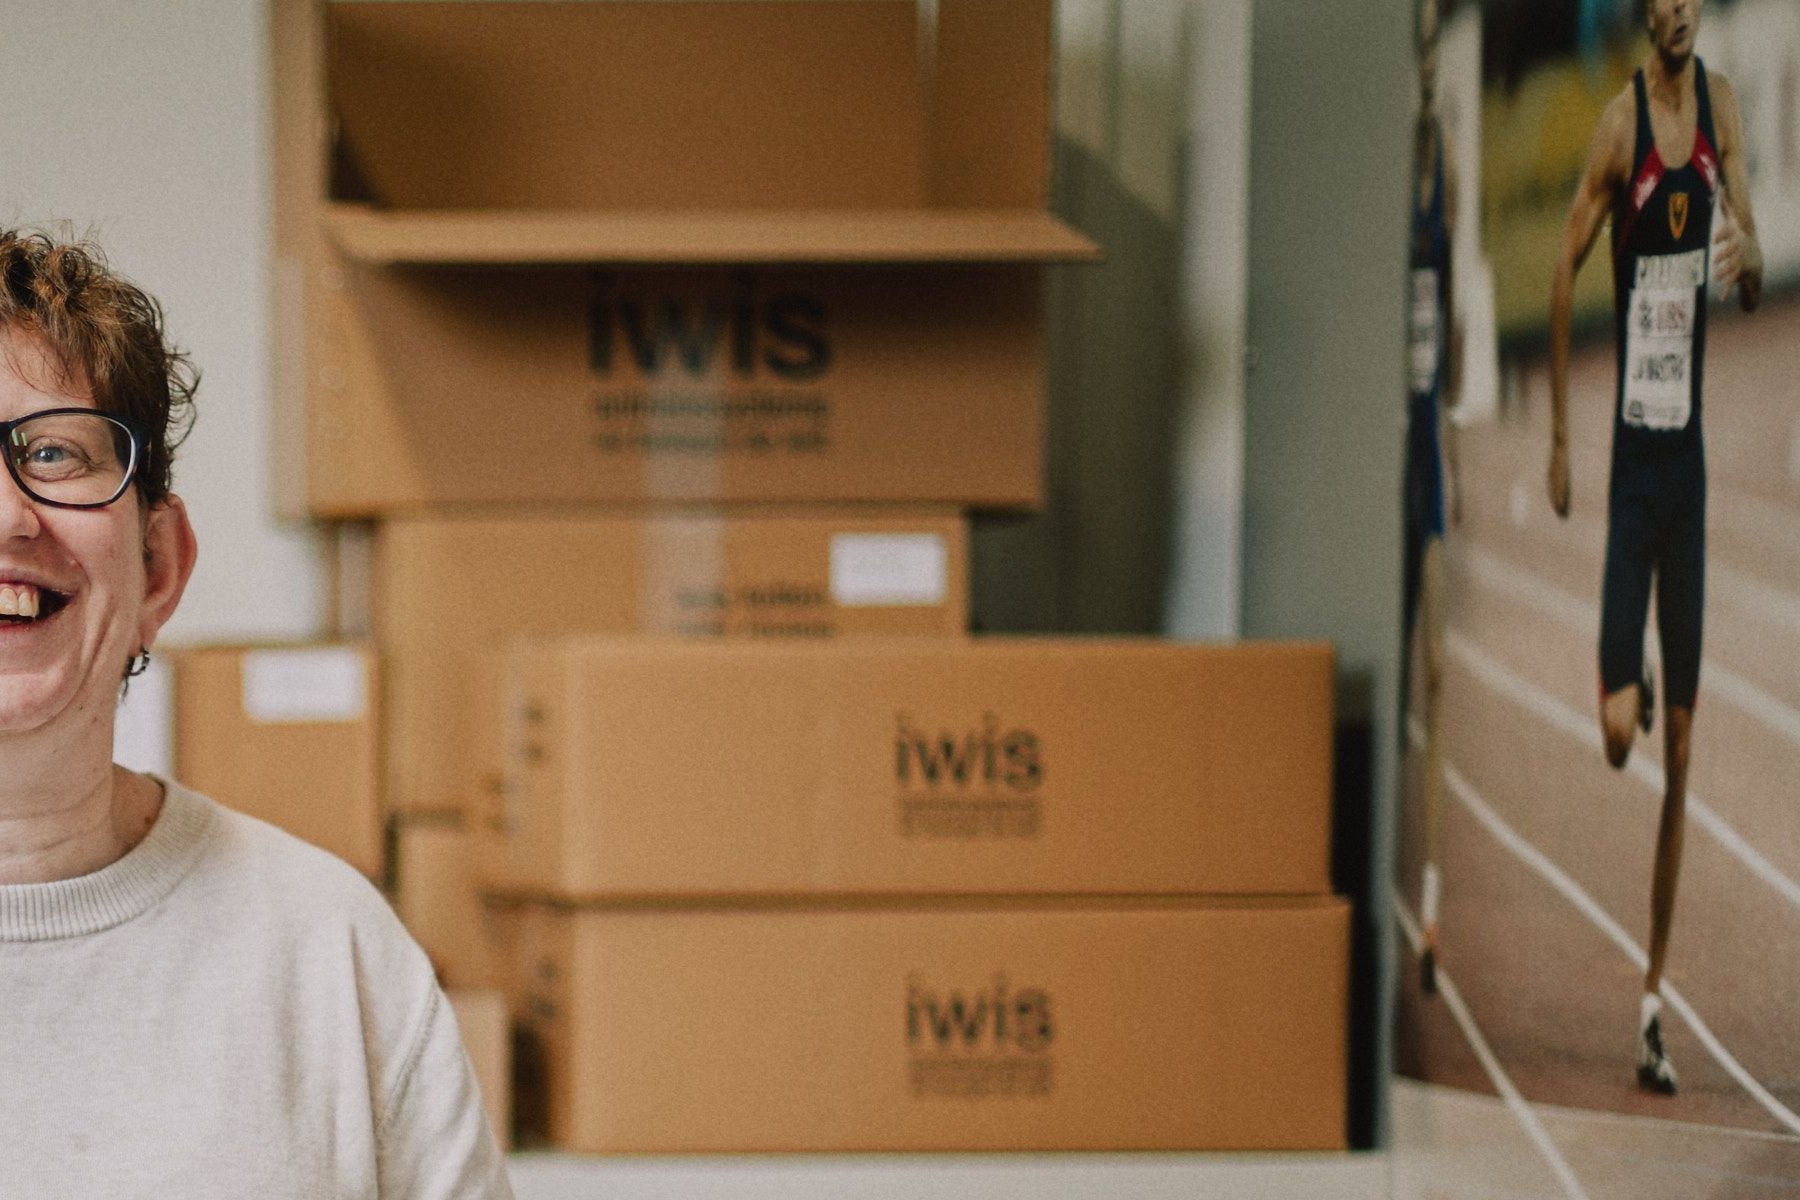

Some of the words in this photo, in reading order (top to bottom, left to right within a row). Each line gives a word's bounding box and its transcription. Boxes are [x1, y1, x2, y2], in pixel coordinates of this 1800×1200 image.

[588, 266, 834, 381] iwis
[897, 710, 1042, 789] iwis
[908, 970, 1054, 1051] iwis
